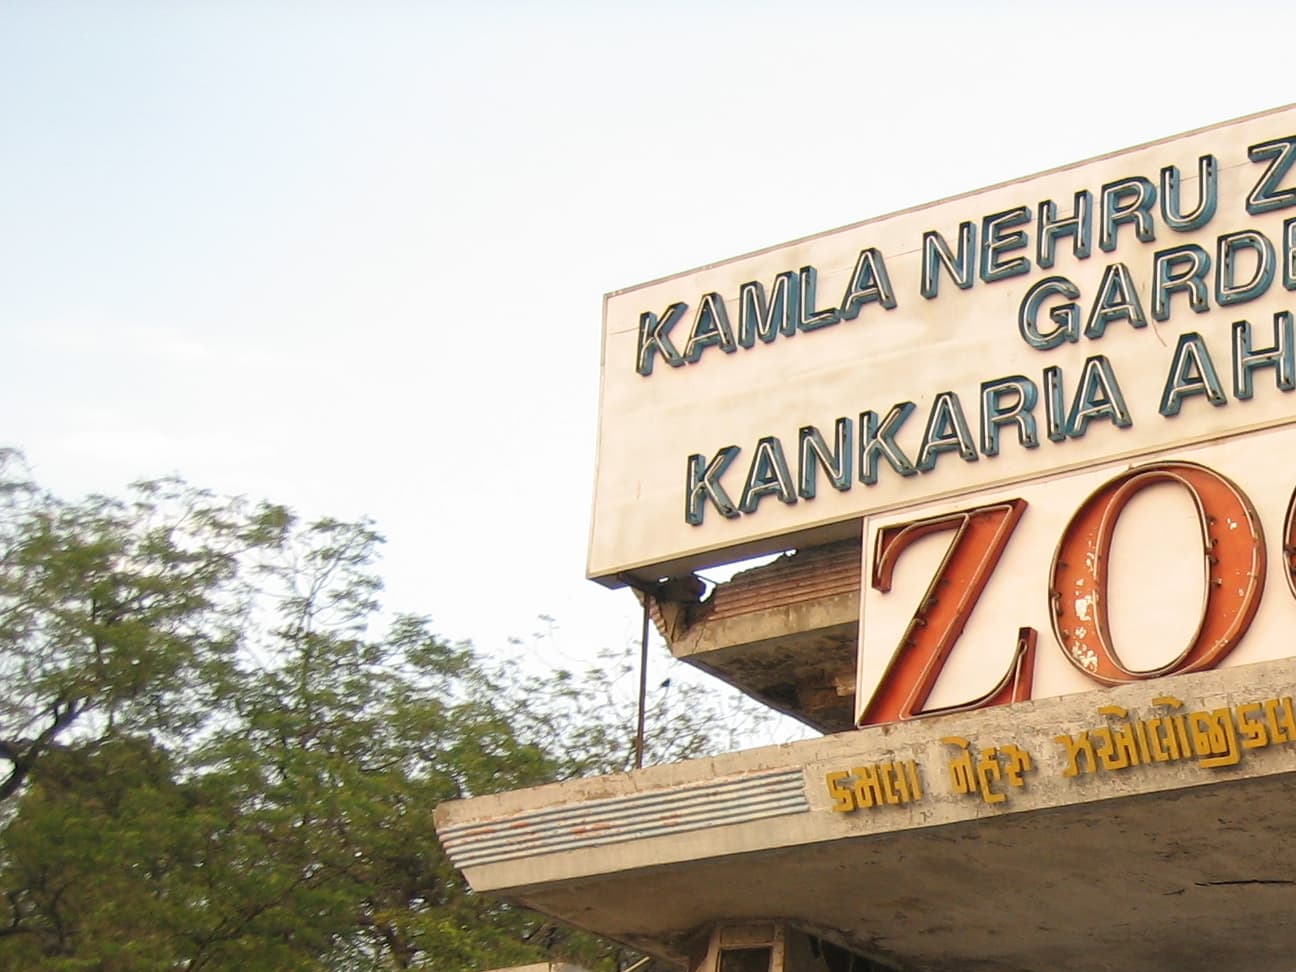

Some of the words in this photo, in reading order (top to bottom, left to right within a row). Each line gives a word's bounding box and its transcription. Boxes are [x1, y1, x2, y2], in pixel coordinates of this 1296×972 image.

[635, 247, 897, 376] KAMLA
[920, 154, 1218, 299] NEHRU
[684, 355, 1132, 525] KANKARIA
[825, 759, 923, 813] કમલા
